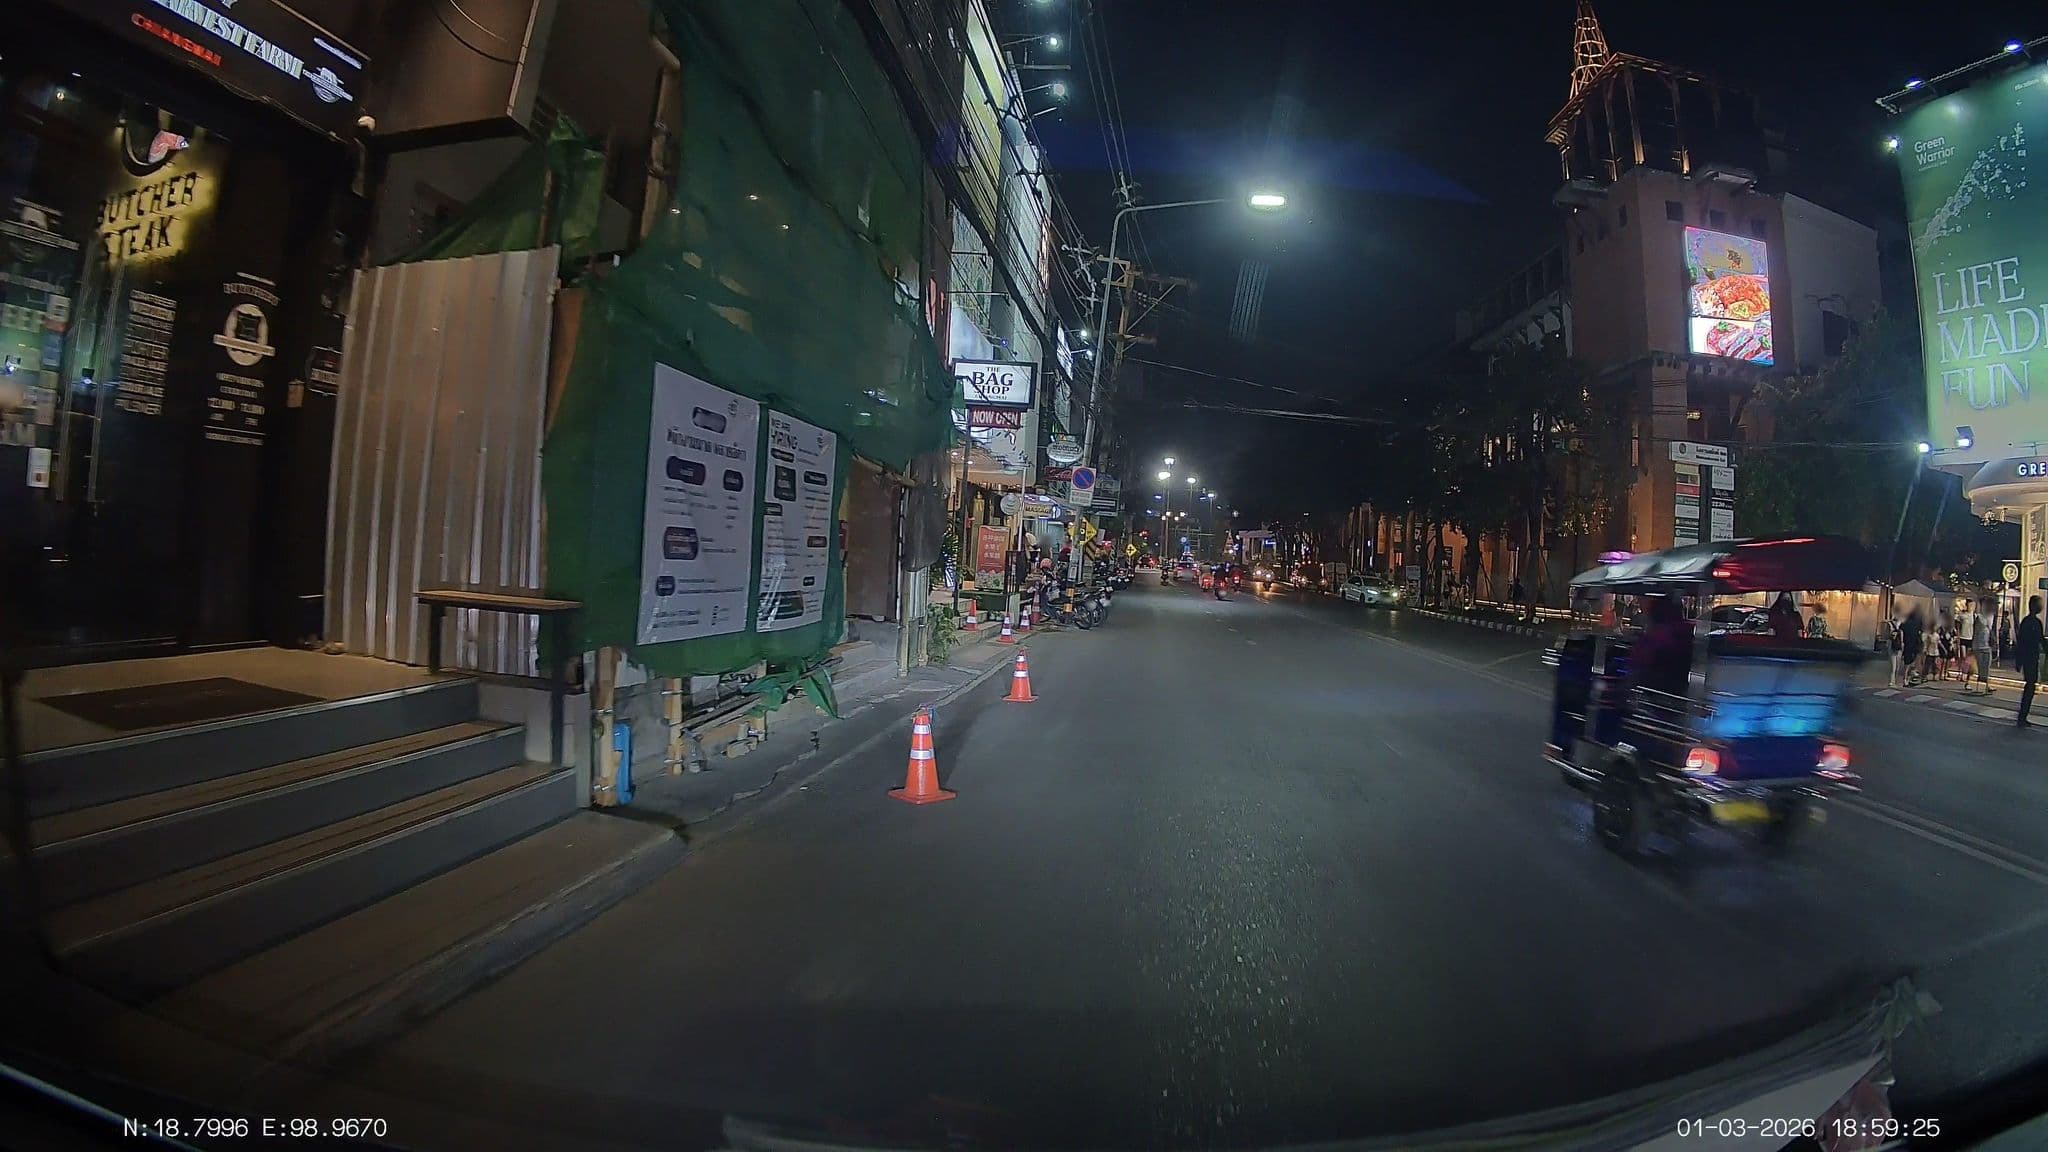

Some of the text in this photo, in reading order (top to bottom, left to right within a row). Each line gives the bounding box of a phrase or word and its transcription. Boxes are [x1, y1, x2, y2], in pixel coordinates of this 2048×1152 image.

[1914, 136, 1945, 153] Green
[1916, 146, 1955, 165] Warrior
[1932, 257, 2025, 315] LIFE
[973, 371, 1013, 386] BAG
[1941, 360, 2030, 410] FUN
[973, 409, 1018, 427] NOW OPEN
[2018, 462, 2046, 476] GRE
